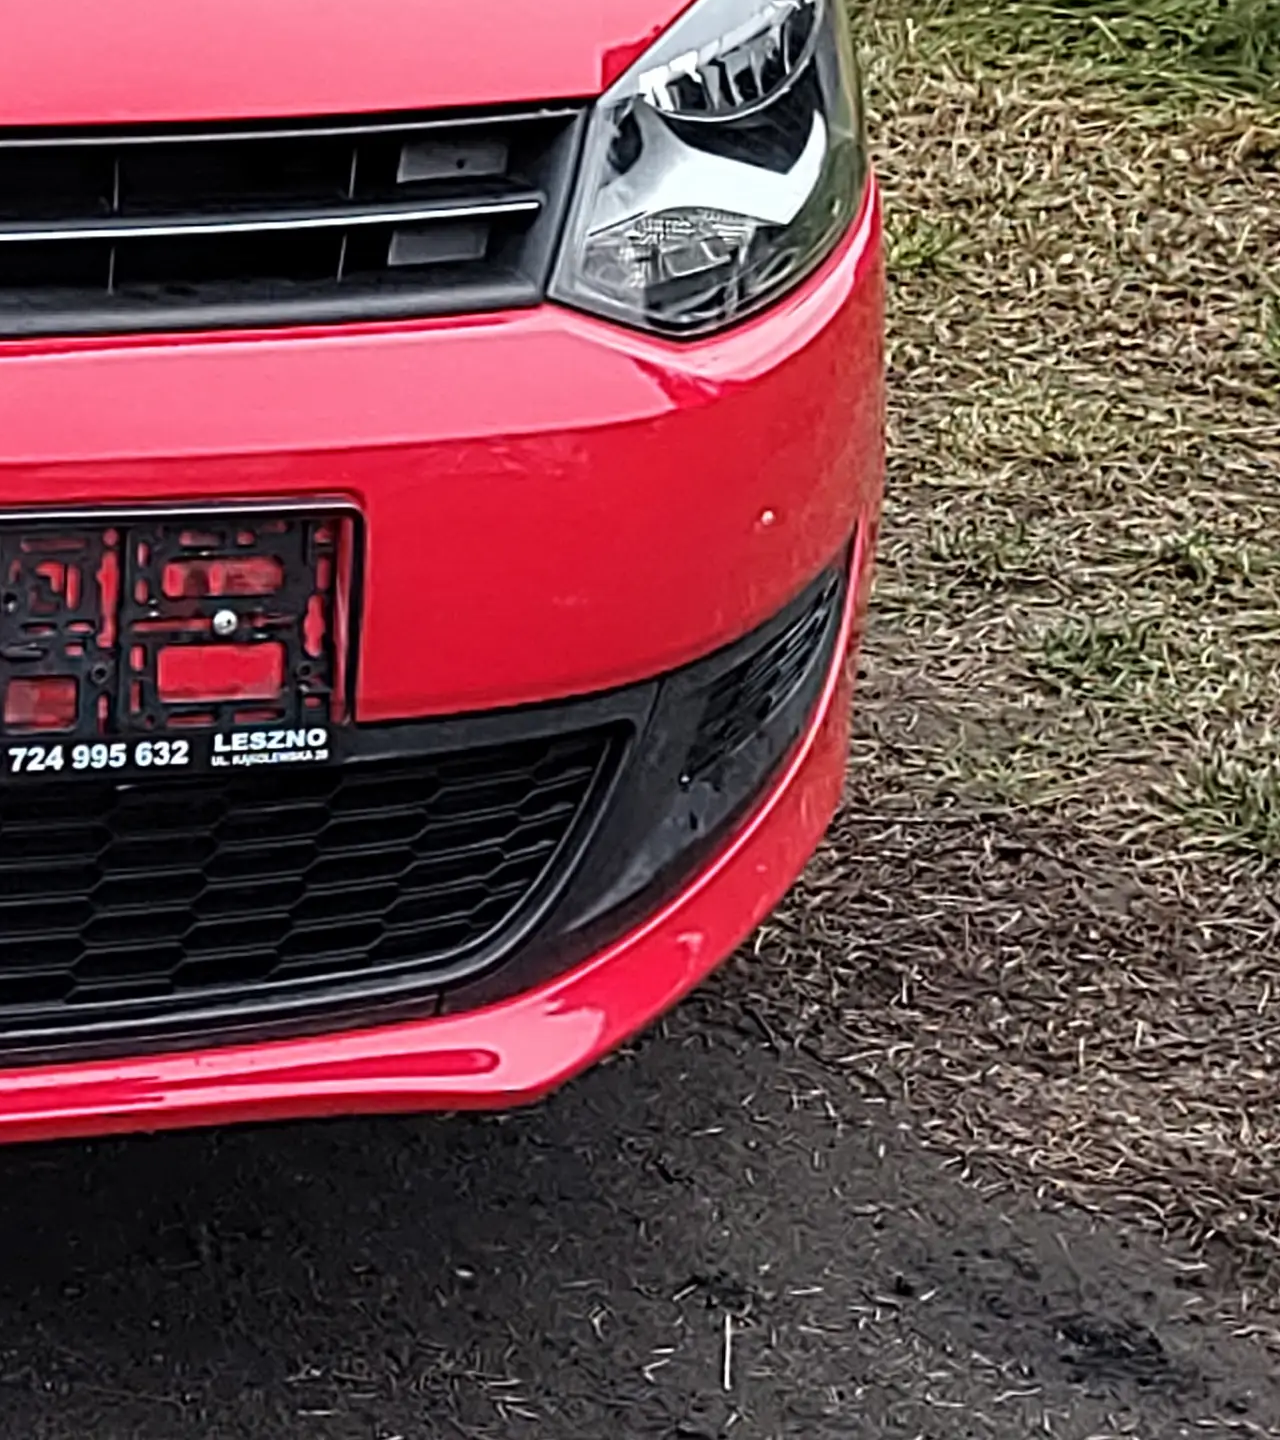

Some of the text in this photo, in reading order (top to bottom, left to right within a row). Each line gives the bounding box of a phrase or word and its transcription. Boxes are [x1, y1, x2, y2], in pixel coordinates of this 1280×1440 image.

[213, 728, 328, 753] LESZNO
[8, 745, 64, 772] 724
[71, 743, 126, 769] 995
[134, 739, 189, 766] 632
